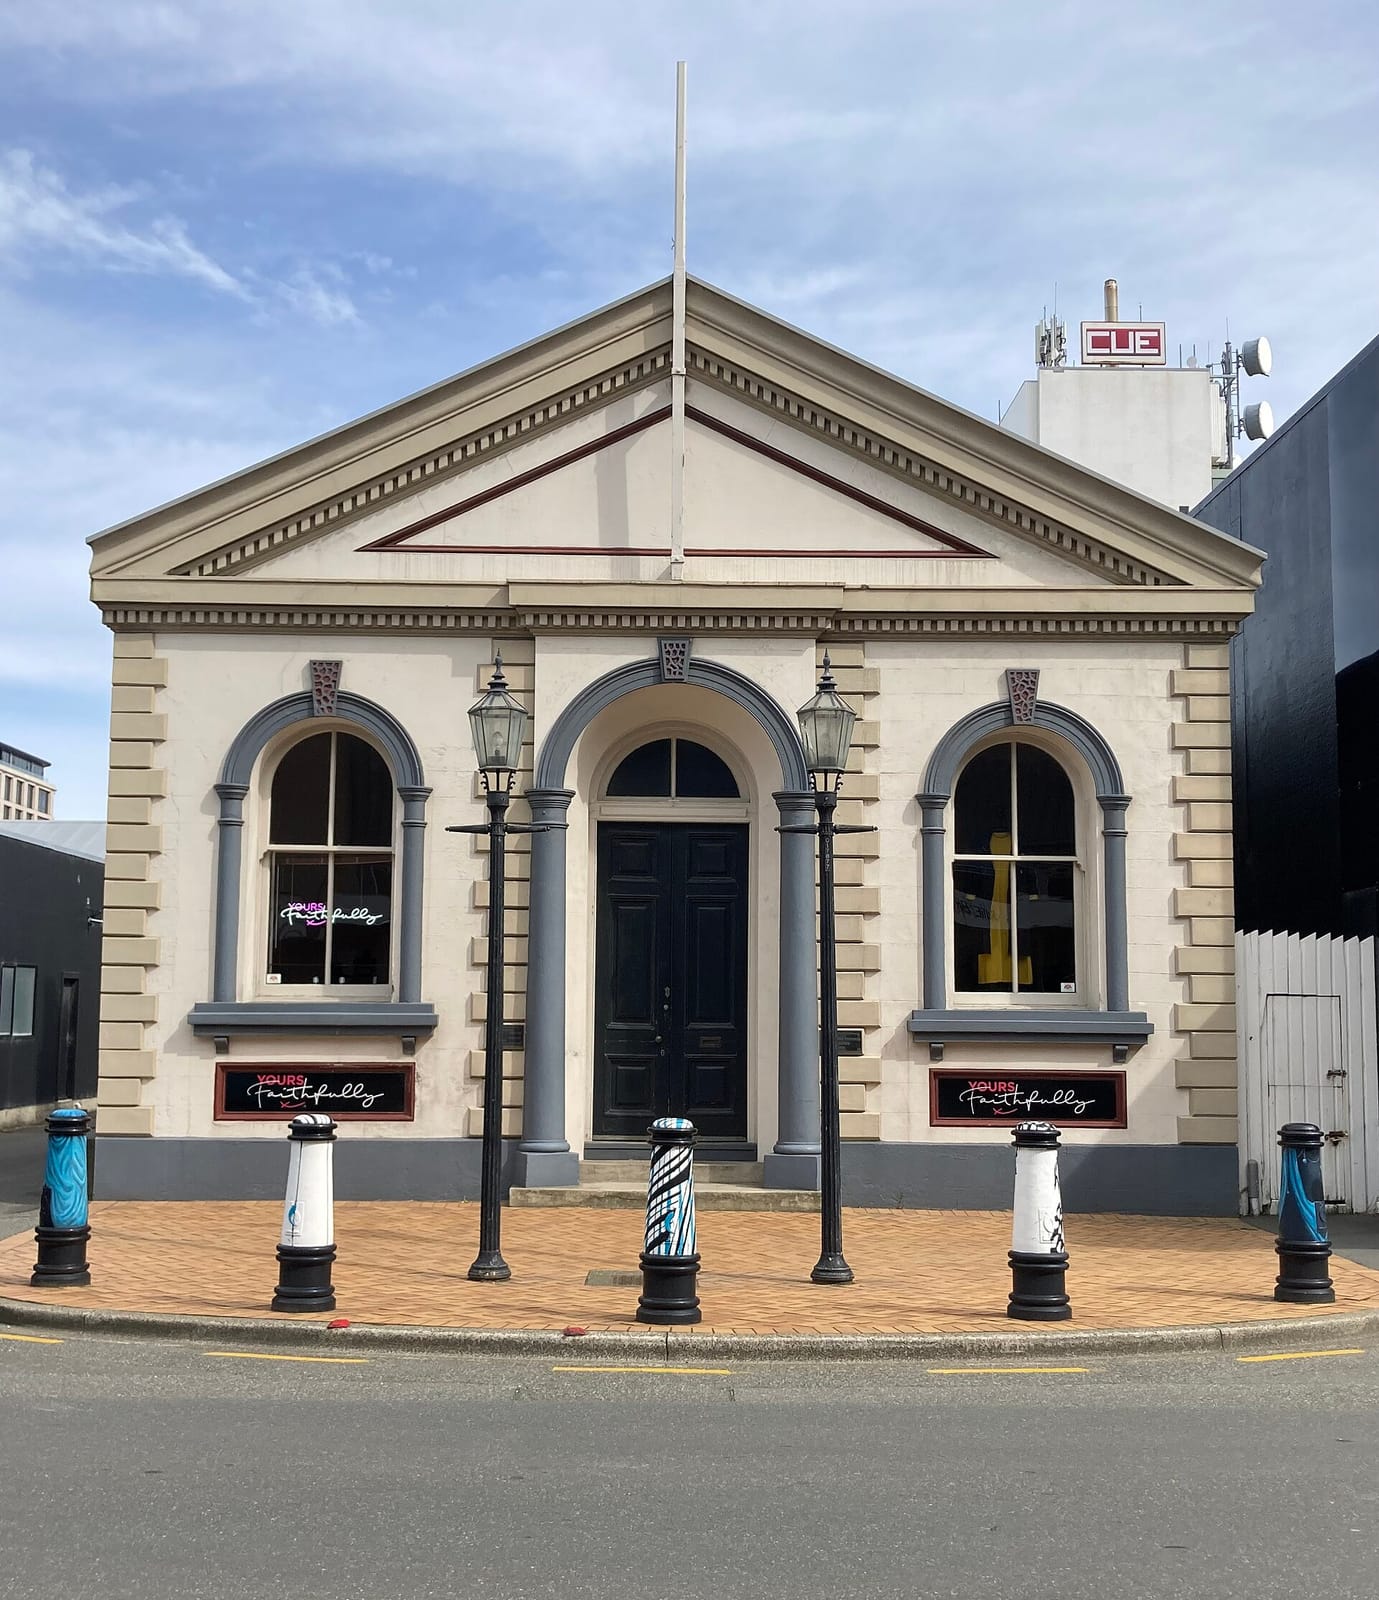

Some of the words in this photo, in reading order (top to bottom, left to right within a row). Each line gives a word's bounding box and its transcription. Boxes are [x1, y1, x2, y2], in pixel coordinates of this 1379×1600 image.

[1086, 331, 1159, 354] CUE
[280, 904, 383, 925] Faithfully
[288, 902, 324, 911] YOURS
[257, 1074, 305, 1086] YOURS
[968, 1081, 1015, 1092] YOURS
[247, 1077, 385, 1108] Faithfully
[959, 1083, 1096, 1114] Faithfully
